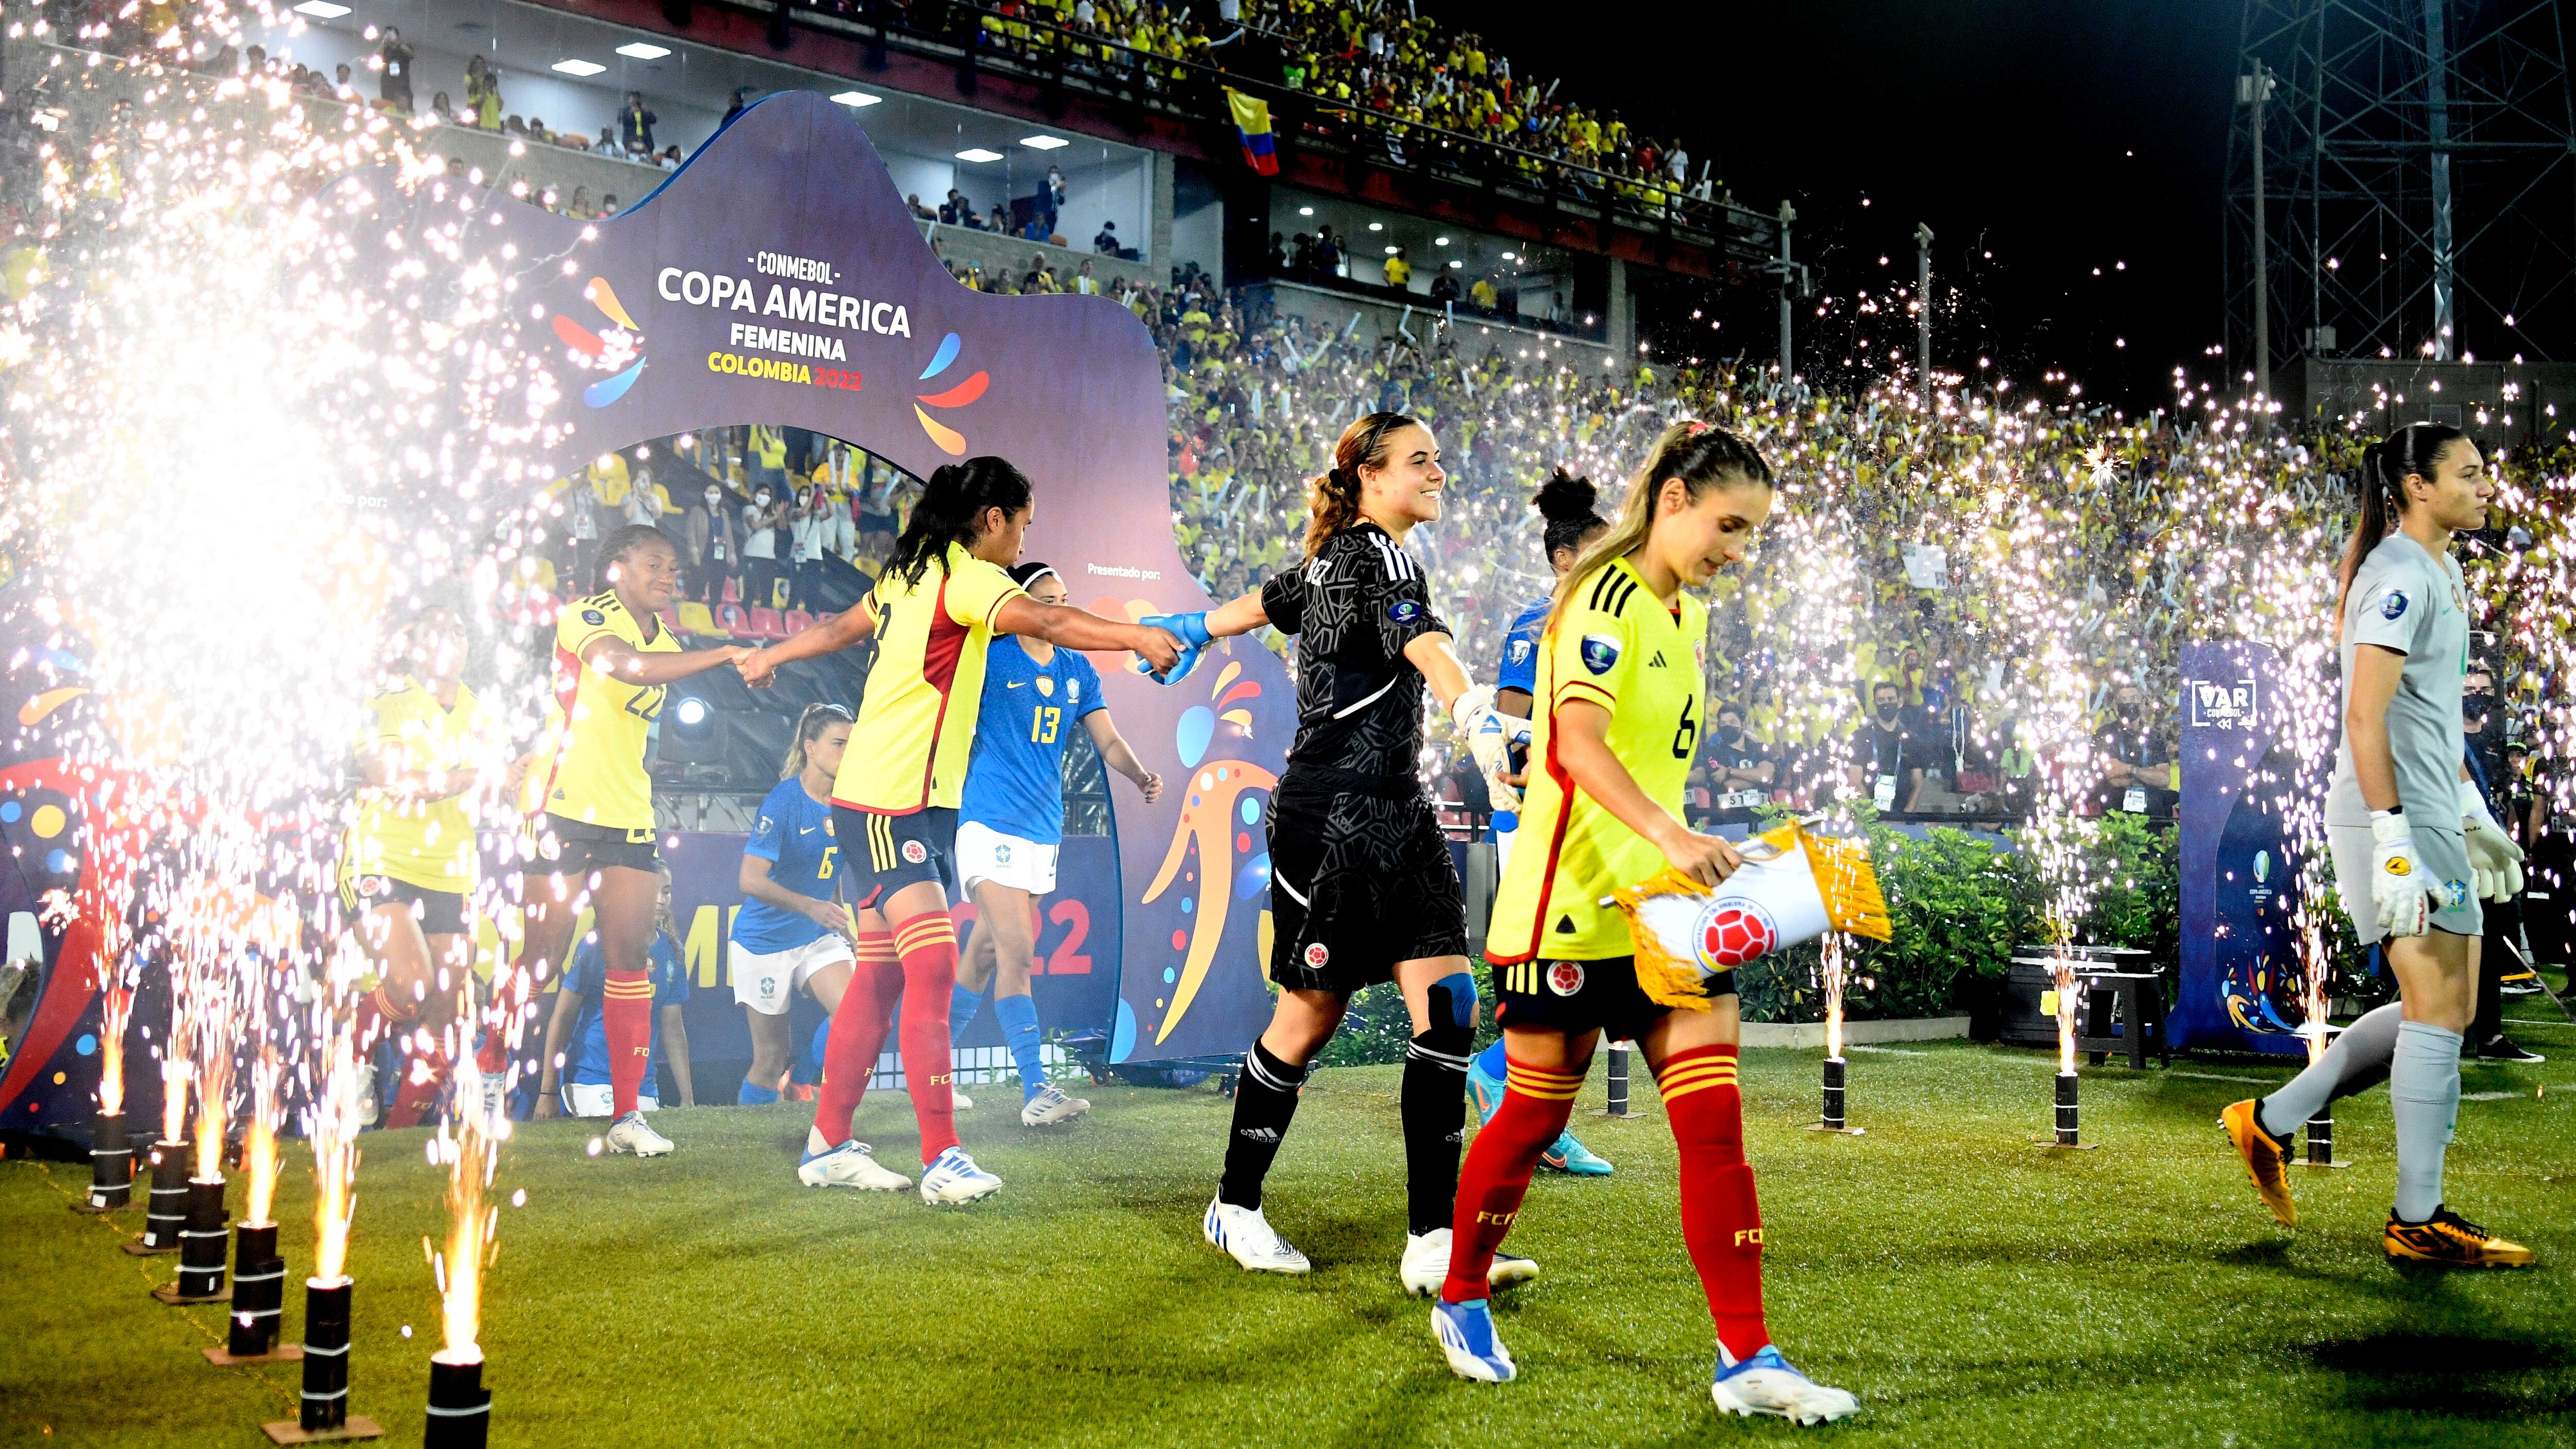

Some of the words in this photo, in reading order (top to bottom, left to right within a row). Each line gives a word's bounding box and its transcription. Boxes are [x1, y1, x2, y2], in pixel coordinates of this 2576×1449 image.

[658, 267, 757, 314] COPA
[762, 284, 911, 338] AMERICA
[730, 322, 846, 362] FEMENINA
[708, 352, 811, 385] COLOMBIA
[814, 367, 862, 391] 2022
[1088, 563, 1141, 578] Presentado
[1141, 570, 1161, 581] por:
[1304, 557, 1332, 586] REZ
[2198, 686, 2248, 707] VAR
[1031, 706, 1061, 743] 13
[1672, 693, 1695, 759] 6
[817, 846, 838, 879] 6
